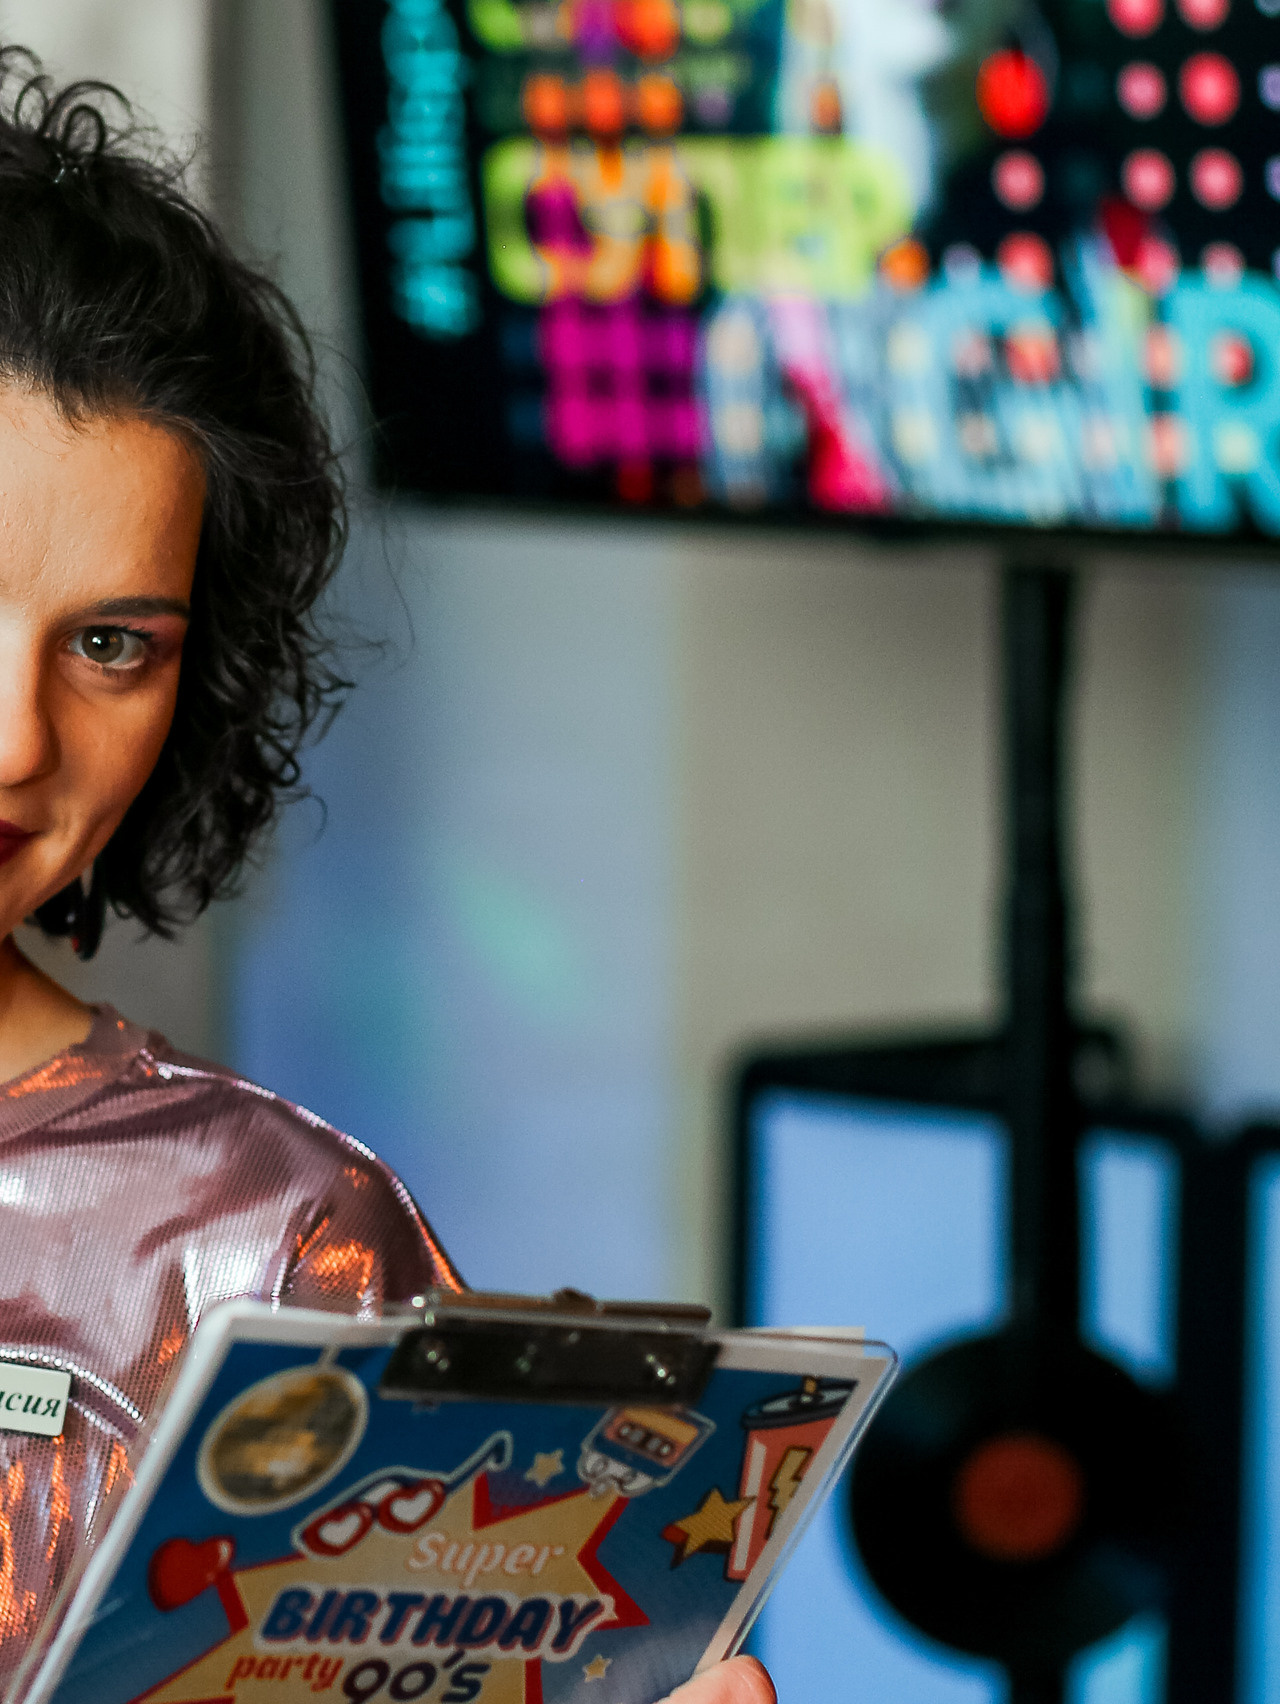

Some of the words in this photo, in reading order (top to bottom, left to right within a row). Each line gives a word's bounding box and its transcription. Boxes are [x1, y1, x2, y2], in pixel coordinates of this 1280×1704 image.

[408, 1531, 565, 1589] Super
[259, 1586, 608, 1655] BIRTHDAY
[225, 1652, 345, 1694] party
